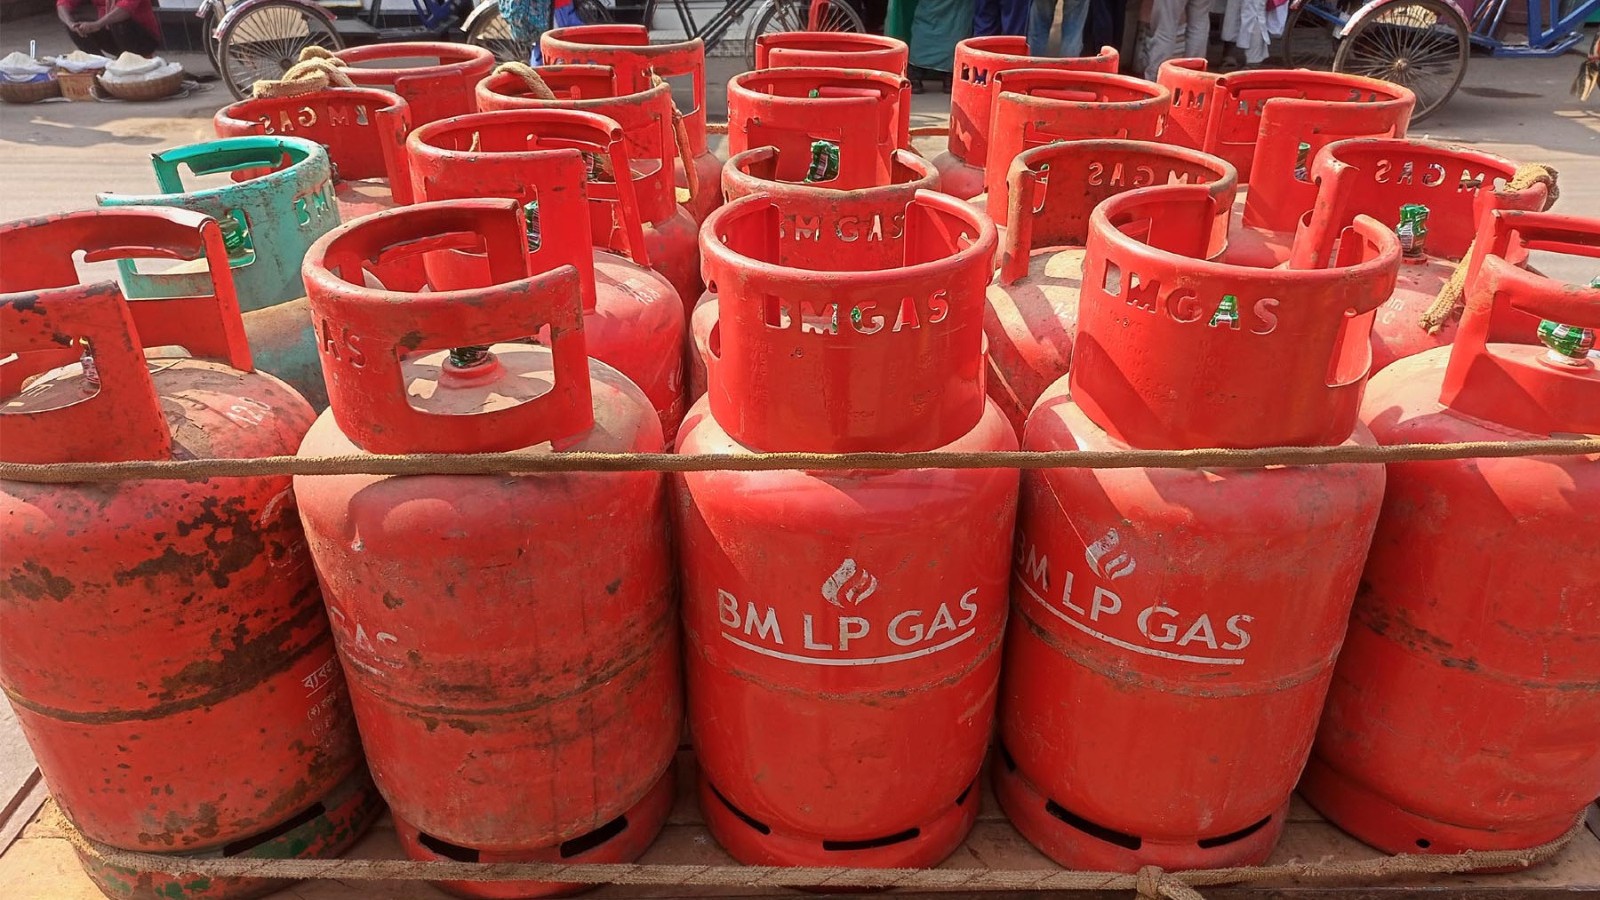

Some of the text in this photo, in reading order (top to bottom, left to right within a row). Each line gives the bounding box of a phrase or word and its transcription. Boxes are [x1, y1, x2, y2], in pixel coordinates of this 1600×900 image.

[836, 214, 905, 241] GAS
[718, 587, 978, 651] BM LP GAS
[1013, 528, 1255, 650] BM LP GAS
